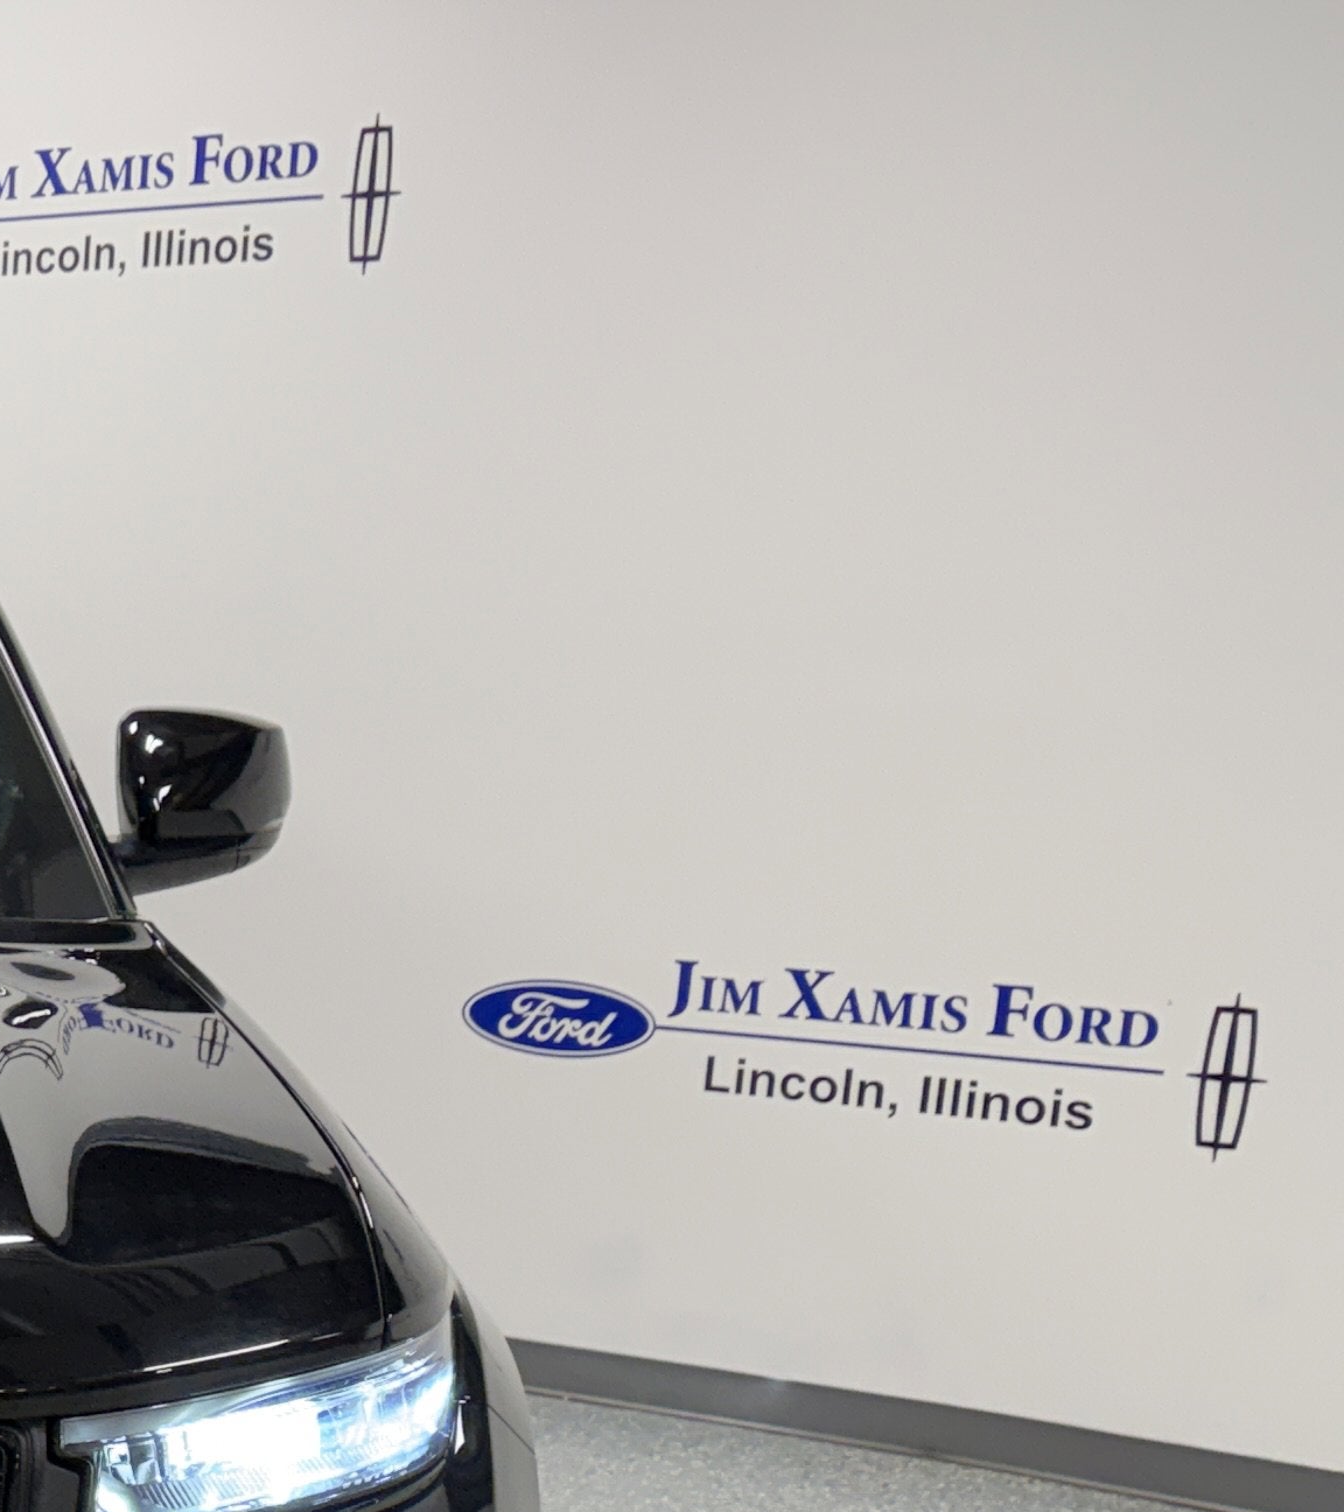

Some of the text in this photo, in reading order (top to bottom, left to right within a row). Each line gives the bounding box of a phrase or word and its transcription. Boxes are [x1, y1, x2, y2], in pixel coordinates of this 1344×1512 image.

[31, 147, 175, 198] XAMIS
[189, 134, 319, 186] FORD
[142, 225, 274, 268] Illinois
[497, 991, 615, 1050] Ford
[667, 960, 1160, 1048] JIM XAMIS FORD
[704, 1056, 1093, 1130] Lincoln, Illinois
